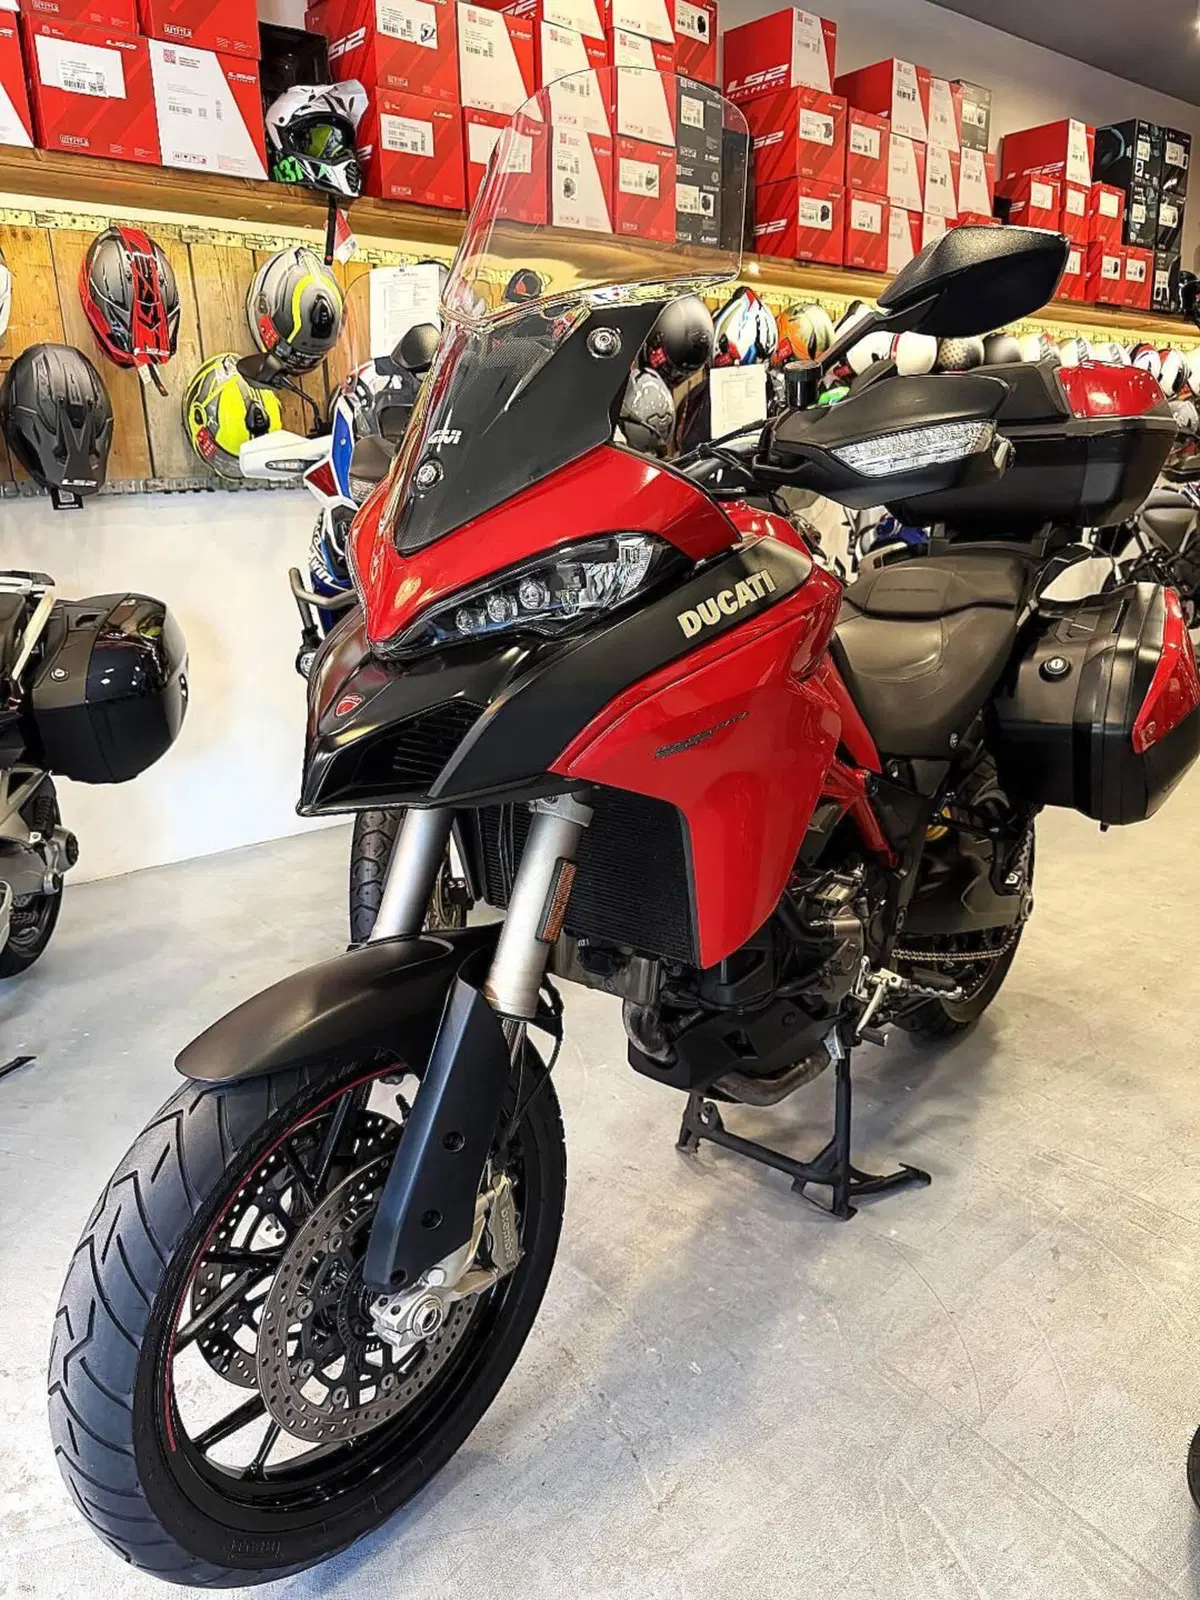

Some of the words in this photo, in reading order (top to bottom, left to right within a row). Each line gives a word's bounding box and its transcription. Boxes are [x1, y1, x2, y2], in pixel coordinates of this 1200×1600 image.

[328, 26, 366, 60] S2
[727, 63, 789, 93] LS2
[753, 130, 785, 149] S2
[753, 219, 788, 237] S2
[677, 569, 776, 639] DUCATI
[501, 1203, 513, 1259] brembo
